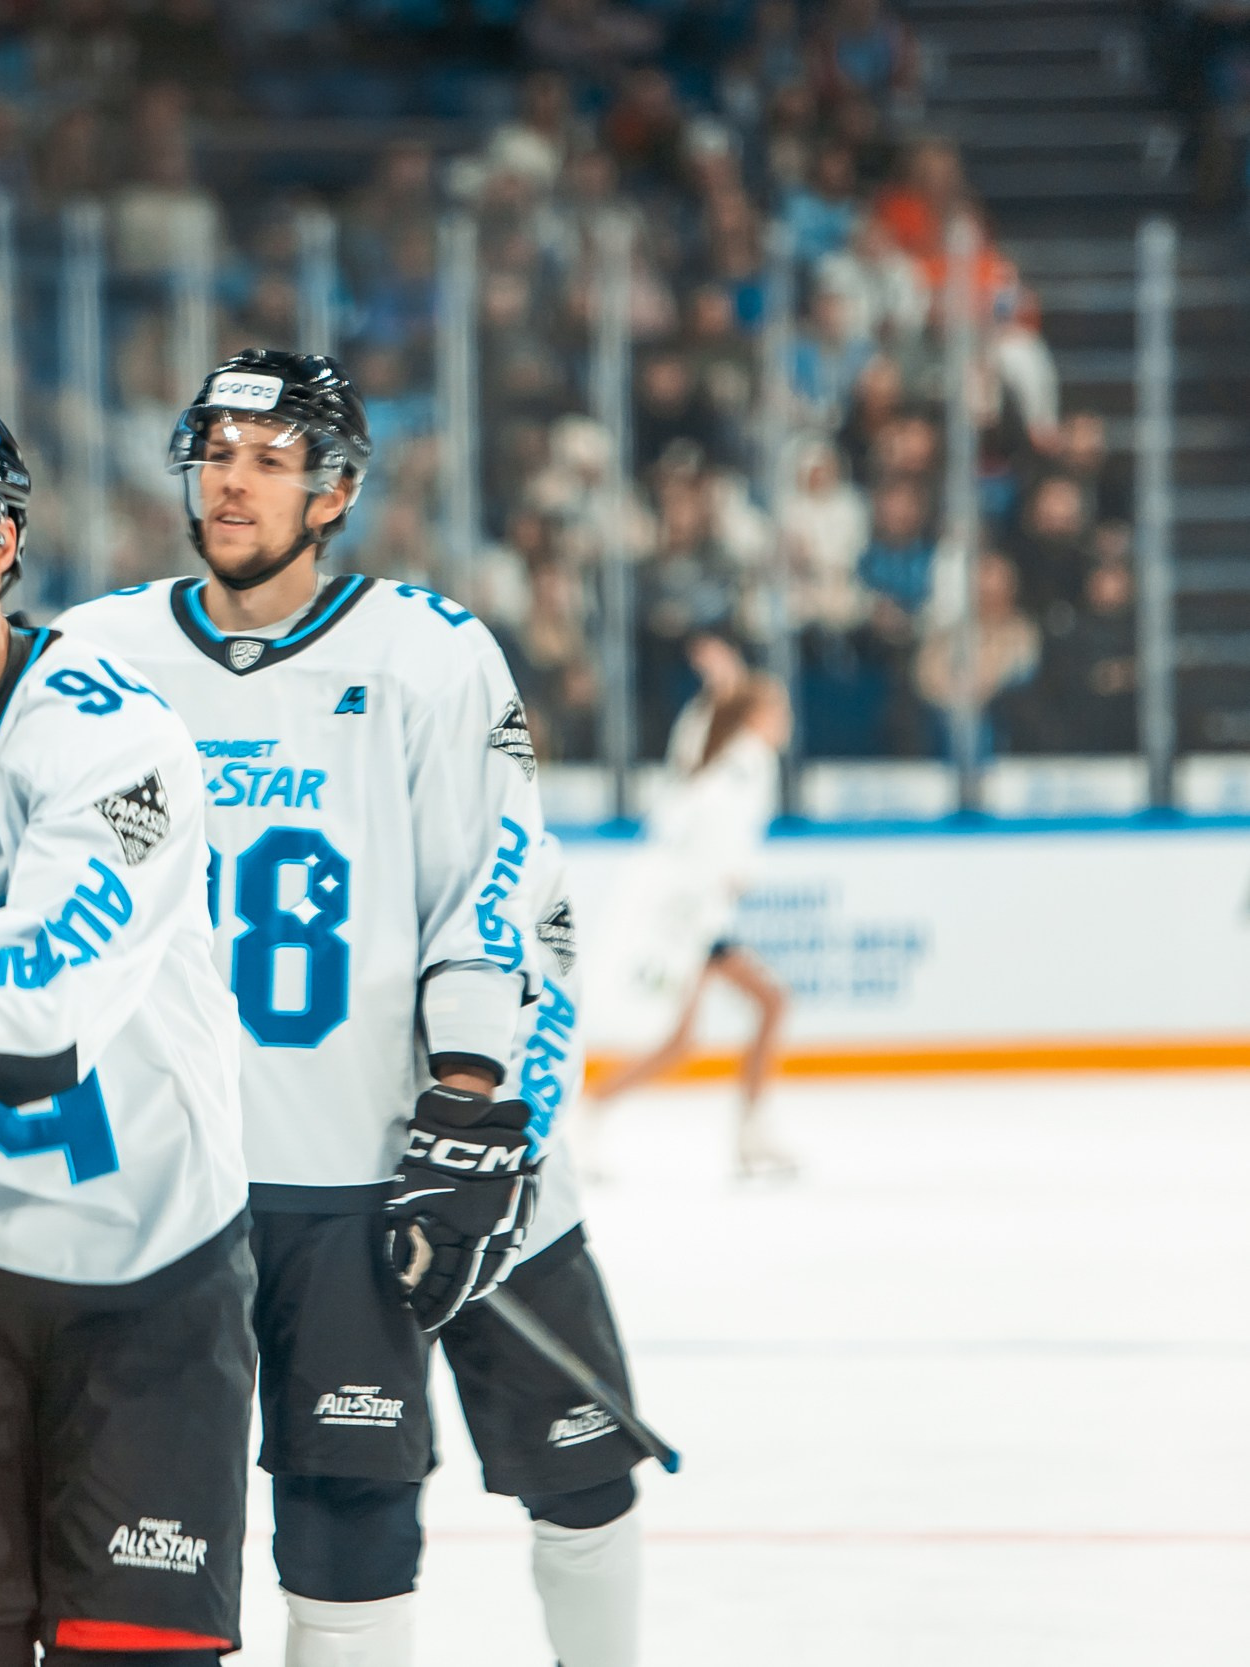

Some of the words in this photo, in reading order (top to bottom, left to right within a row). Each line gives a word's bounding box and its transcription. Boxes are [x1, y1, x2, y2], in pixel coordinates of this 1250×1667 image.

[196, 740, 279, 759] FONBET
[206, 826, 351, 1049] 8
[405, 1128, 529, 1172] CCM
